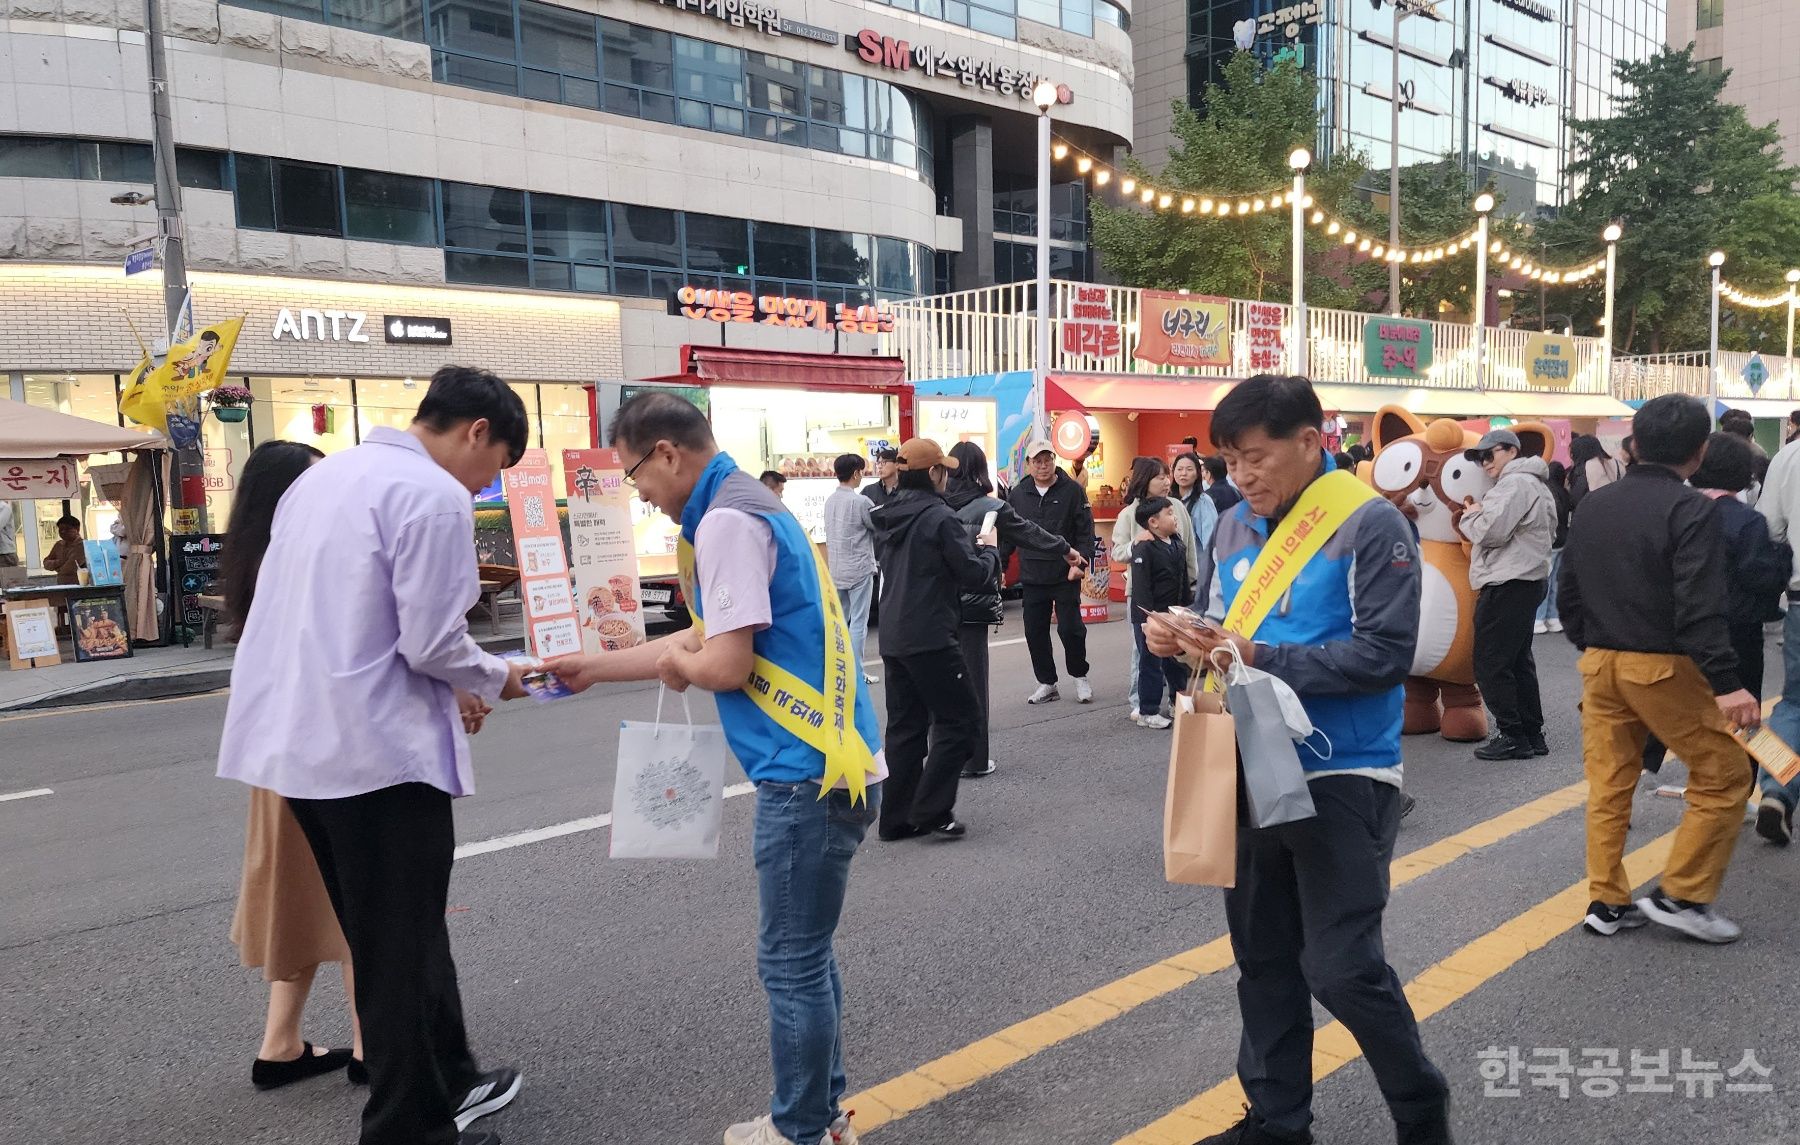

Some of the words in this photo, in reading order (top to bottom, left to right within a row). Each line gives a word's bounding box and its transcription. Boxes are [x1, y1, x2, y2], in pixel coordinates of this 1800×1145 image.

[659, 0, 782, 37] 게임학원
[858, 29, 911, 71] SM
[915, 45, 1036, 101] 에스엠신용정
[677, 286, 755, 322] 인생을
[835, 302, 879, 335] 농심
[1078, 287, 1107, 303] 농심과
[272, 307, 370, 343] ANTZ
[1163, 308, 1210, 338] 너구리
[1250, 303, 1283, 326] 인생을
[1063, 322, 1121, 357] 미각존
[1250, 350, 1272, 369] 농심
[575, 465, 599, 503] 辛
